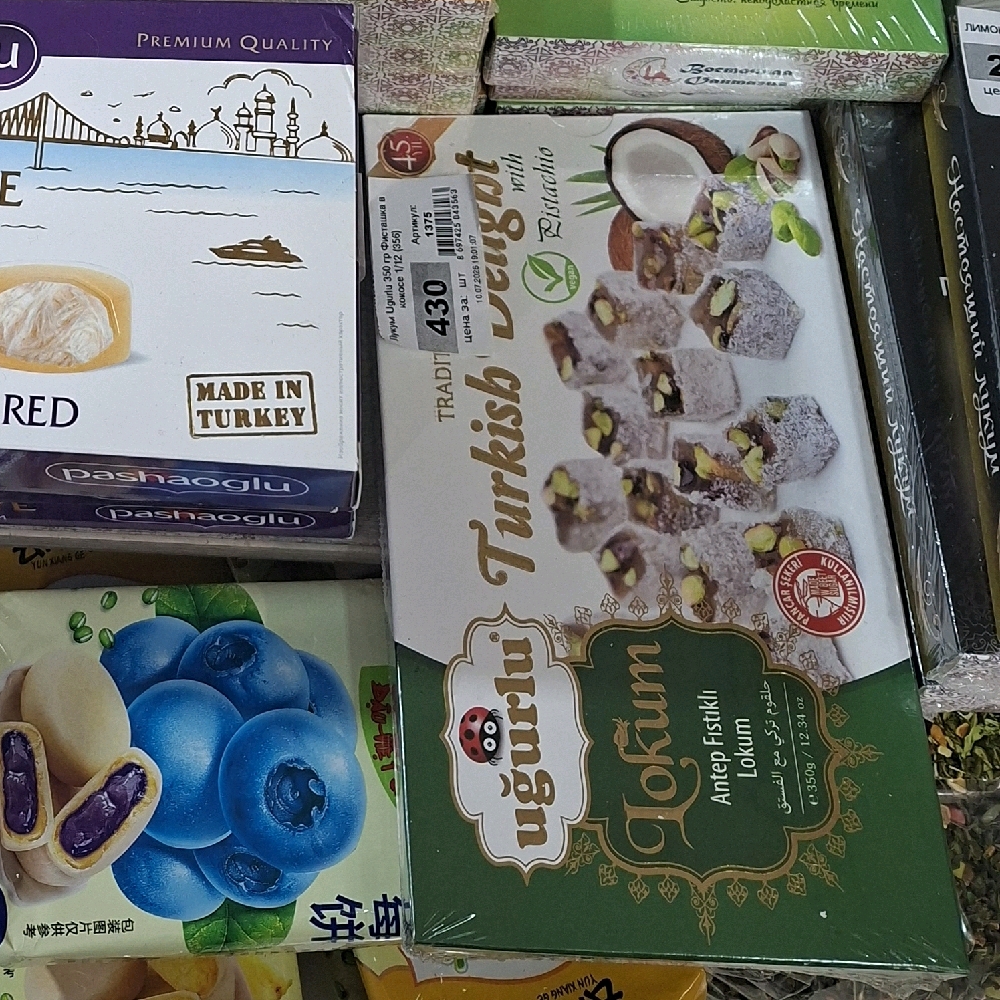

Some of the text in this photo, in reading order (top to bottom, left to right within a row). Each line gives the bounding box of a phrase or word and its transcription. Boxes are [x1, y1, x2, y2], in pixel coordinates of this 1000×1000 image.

[137, 32, 333, 54] PREMIUM QUALITY
[500, 152, 527, 193] with
[532, 145, 563, 243] Pistachio
[379, 204, 390, 251] Фисташка
[409, 204, 421, 246] Артикул:
[423, 211, 434, 238] 1375
[383, 252, 392, 264] гр
[383, 265, 392, 282] 350
[391, 229, 407, 309] кокосе 1/12 (356)
[567, 264, 579, 292] vegan
[385, 284, 397, 314] Ugurlu
[423, 279, 451, 338] 430
[851, 208, 894, 402] Настоящий
[947, 155, 1000, 477] Настоящий лукум
[388, 316, 399, 342] Лукум
[196, 380, 303, 401] MADE IN
[436, 351, 455, 423] TRADIT
[196, 407, 306, 430] TURKEY
[64, 467, 292, 495] pashaoglu
[465, 365, 536, 587] Turkish
[109, 506, 301, 529] pashaoglu
[499, 636, 557, 849] uğurlu
[613, 640, 702, 856] Lokum
[698, 688, 732, 806] Antep Fıstıklı
[733, 717, 759, 779] Lokum
[22, 916, 135, 939] 包装图片仅供参考
